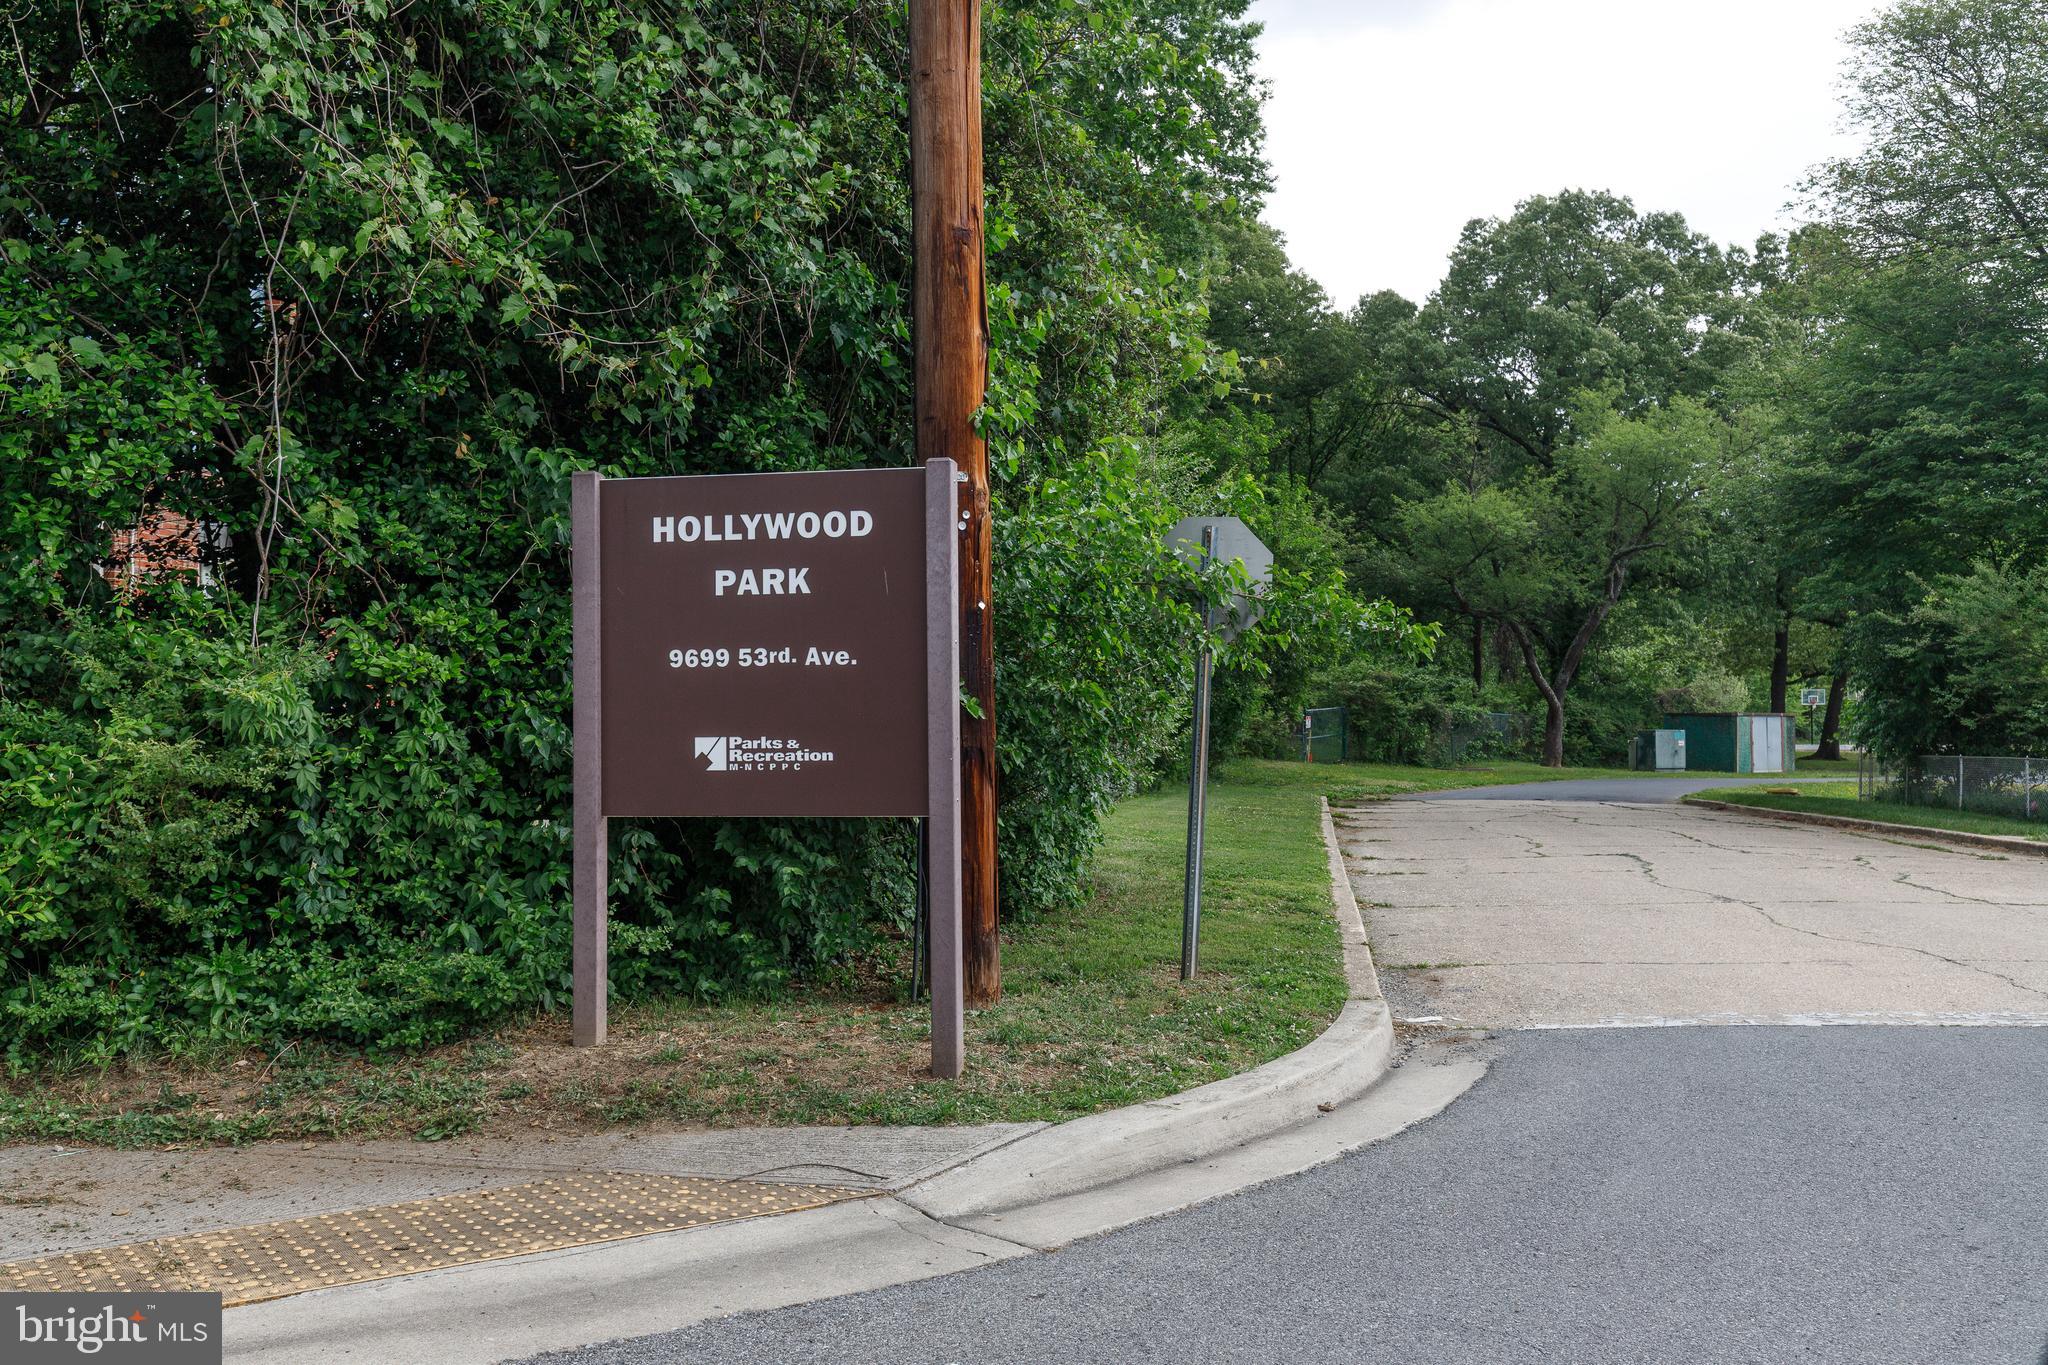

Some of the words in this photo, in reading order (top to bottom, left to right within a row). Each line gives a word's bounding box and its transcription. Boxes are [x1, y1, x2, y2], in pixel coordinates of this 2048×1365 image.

[653, 510, 873, 543] HOLLYWOOD
[715, 567, 812, 596] PARK
[669, 648, 730, 668] 9699
[738, 646, 797, 667] 53rd.
[804, 646, 857, 666] Ave.
[729, 736, 783, 750] Parks
[786, 739, 800, 749] &
[729, 749, 834, 762] Recreation
